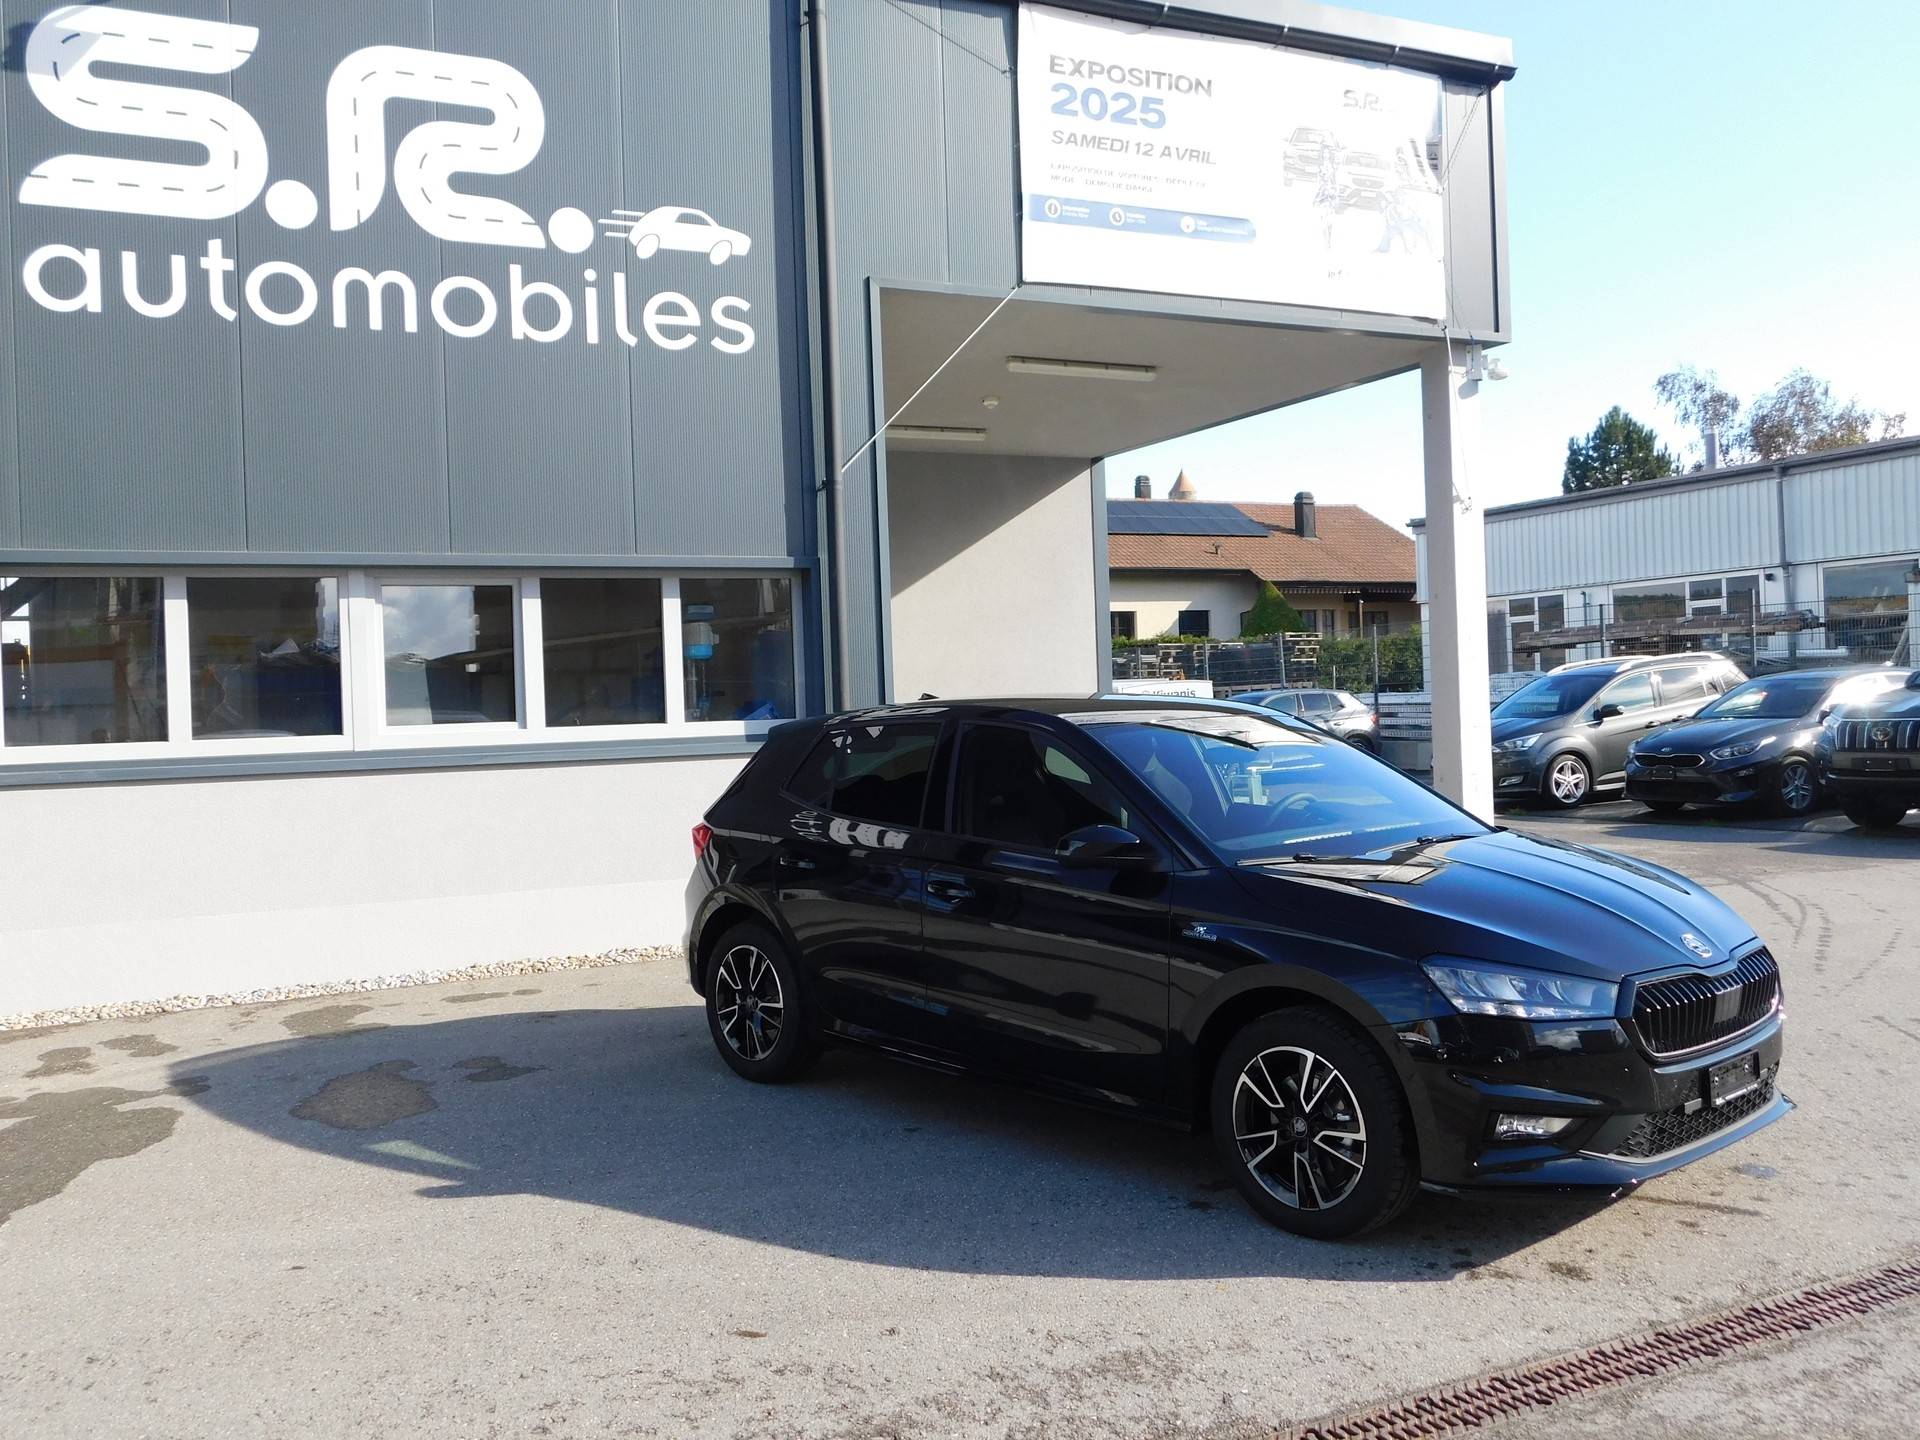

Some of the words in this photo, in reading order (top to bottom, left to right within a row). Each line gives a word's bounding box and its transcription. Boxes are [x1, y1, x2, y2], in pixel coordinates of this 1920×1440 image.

[1049, 55, 1212, 98] EXPOSITION
[1050, 82, 1166, 129] 2025
[1051, 130, 1130, 154] SAMEDI
[1135, 141, 1154, 157] 12
[1159, 145, 1217, 165] AVRIL
[23, 238, 755, 354] automobiles
